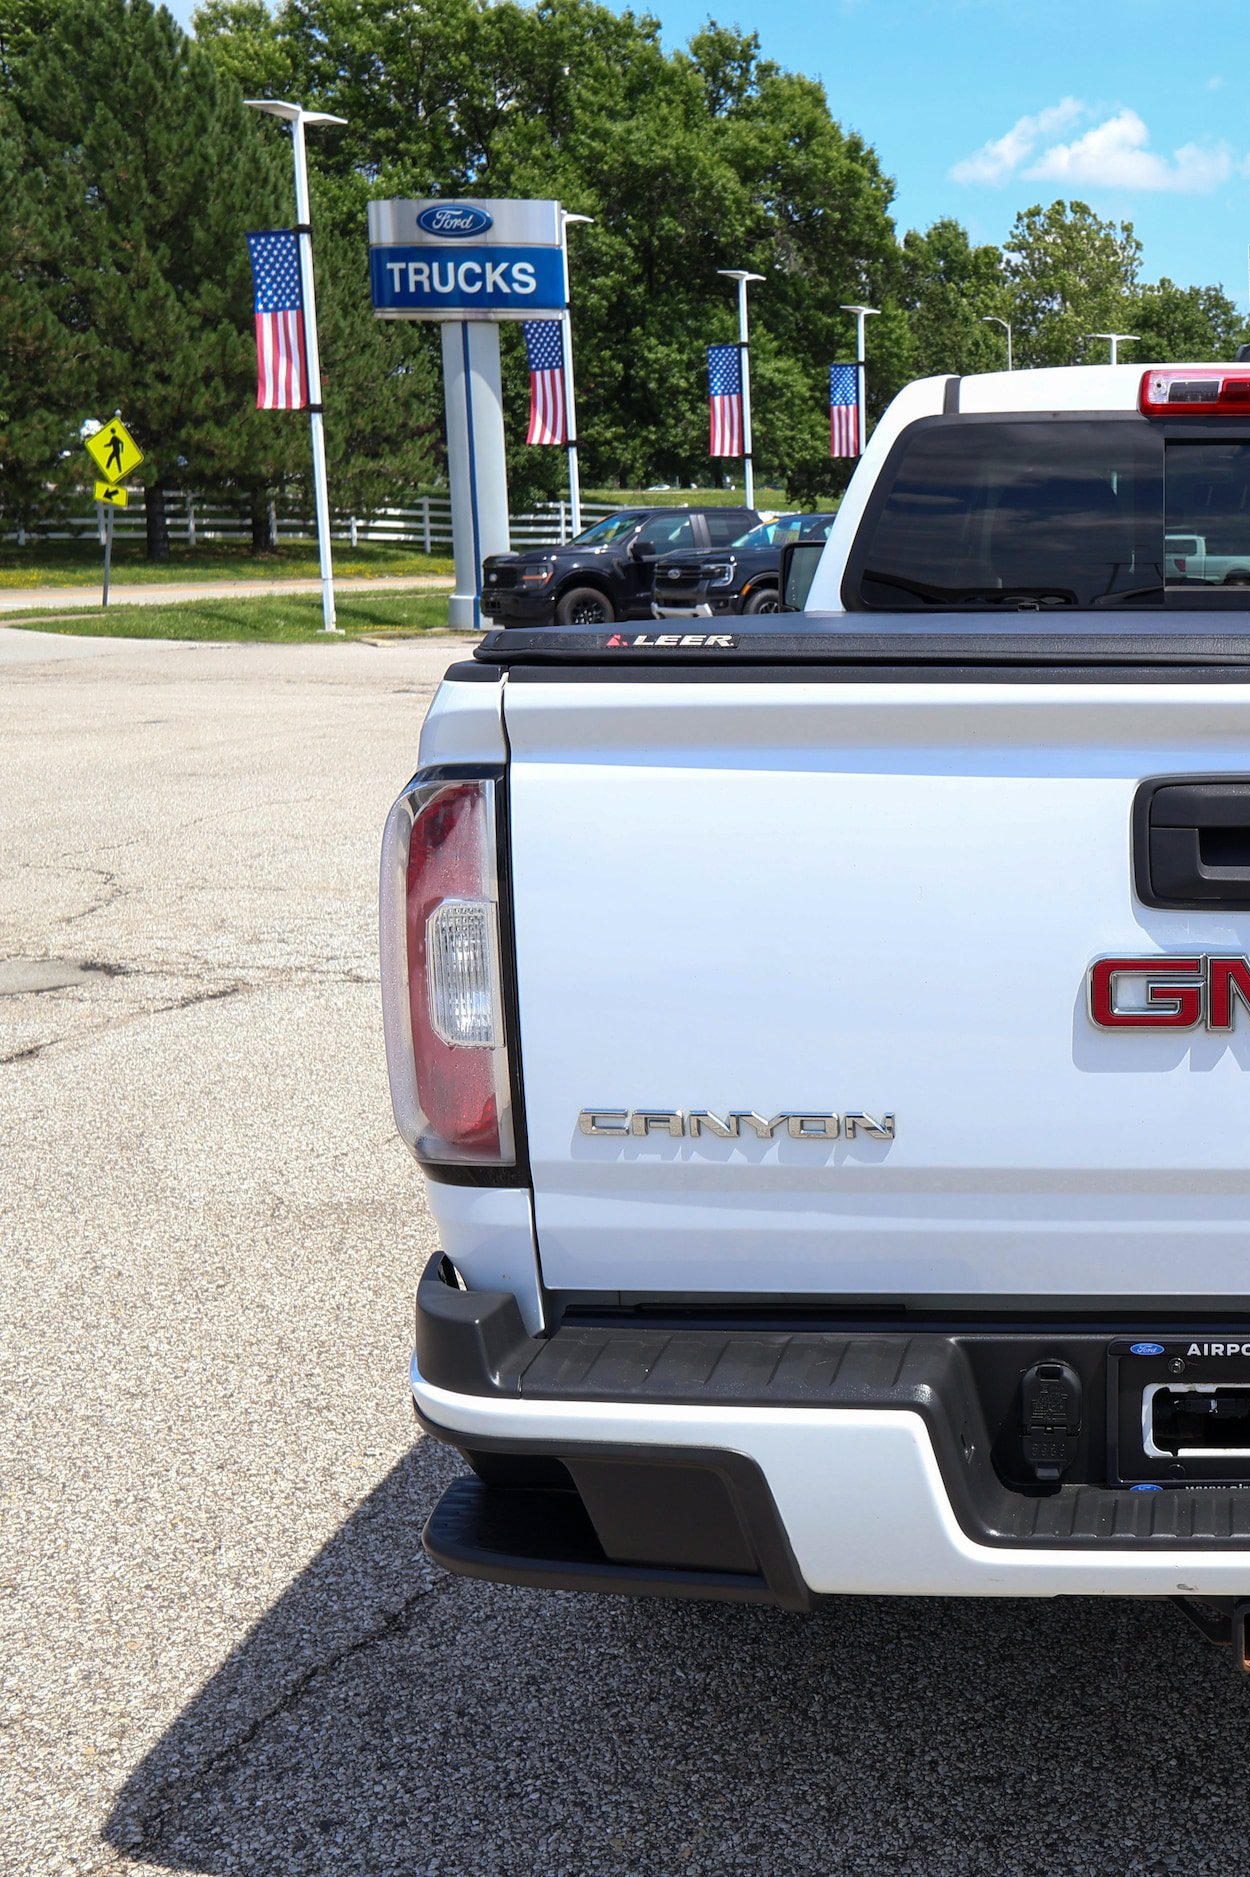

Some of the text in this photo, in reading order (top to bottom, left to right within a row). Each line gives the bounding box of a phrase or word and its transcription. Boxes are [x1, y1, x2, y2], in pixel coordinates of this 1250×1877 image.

[432, 209, 474, 230] Ford
[386, 261, 537, 294] TRUCKS
[632, 634, 733, 647] LEER
[579, 1108, 895, 1139] CANYON
